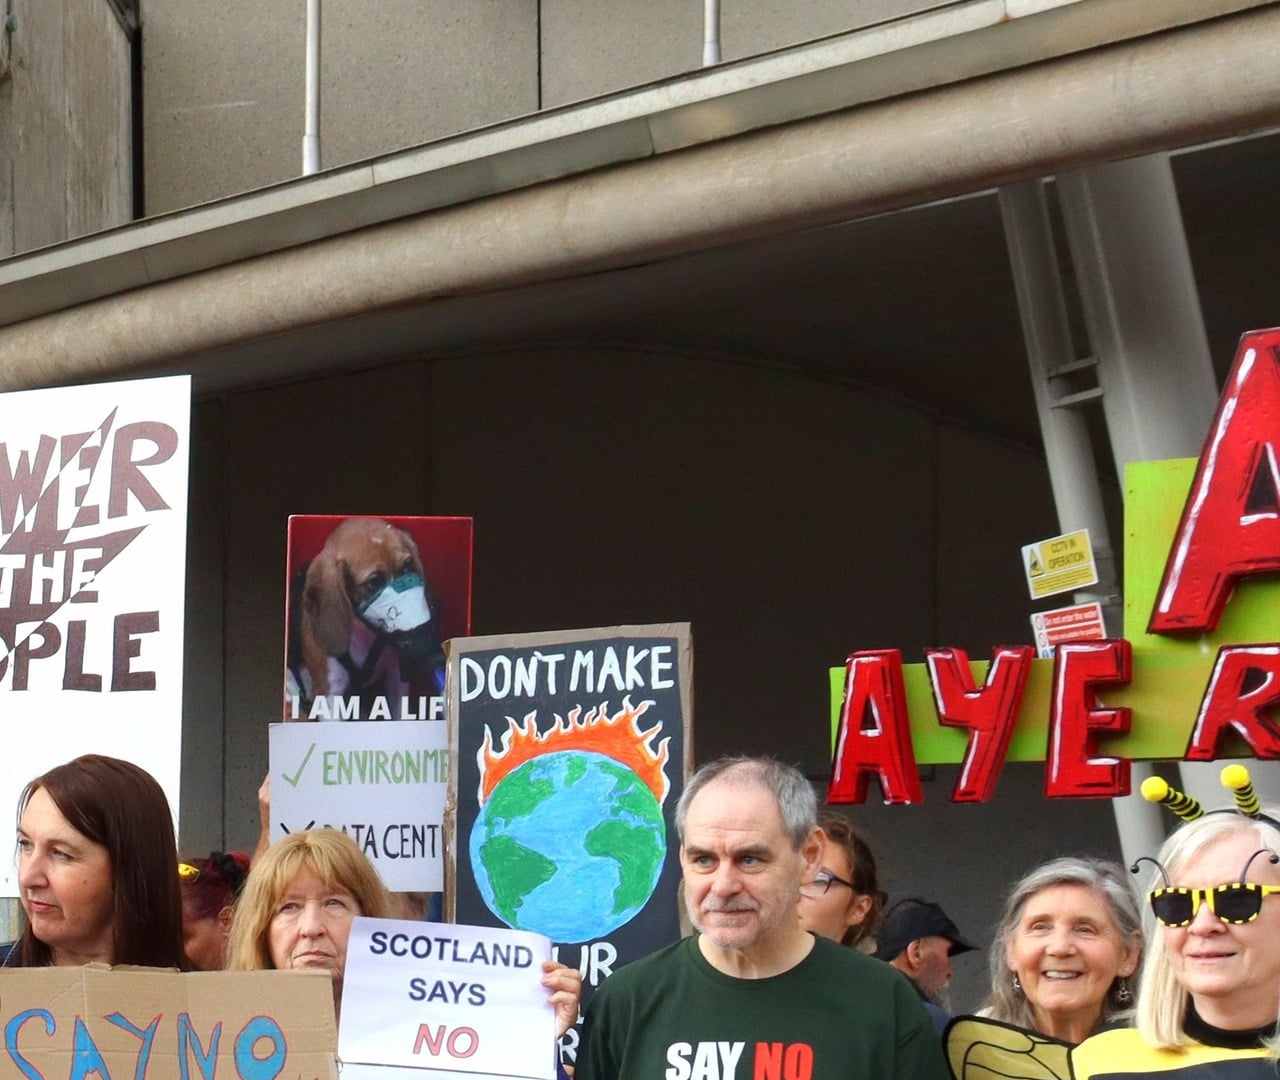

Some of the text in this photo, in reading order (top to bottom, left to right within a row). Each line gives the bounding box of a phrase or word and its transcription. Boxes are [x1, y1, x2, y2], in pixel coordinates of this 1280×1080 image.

[569, 645, 674, 693] MAKE
[291, 695, 392, 720] I AM A
[828, 640, 1131, 803] AYE
[370, 931, 533, 969] SCOTLAND
[408, 977, 486, 1007] SAYS
[412, 1023, 479, 1059] NO
